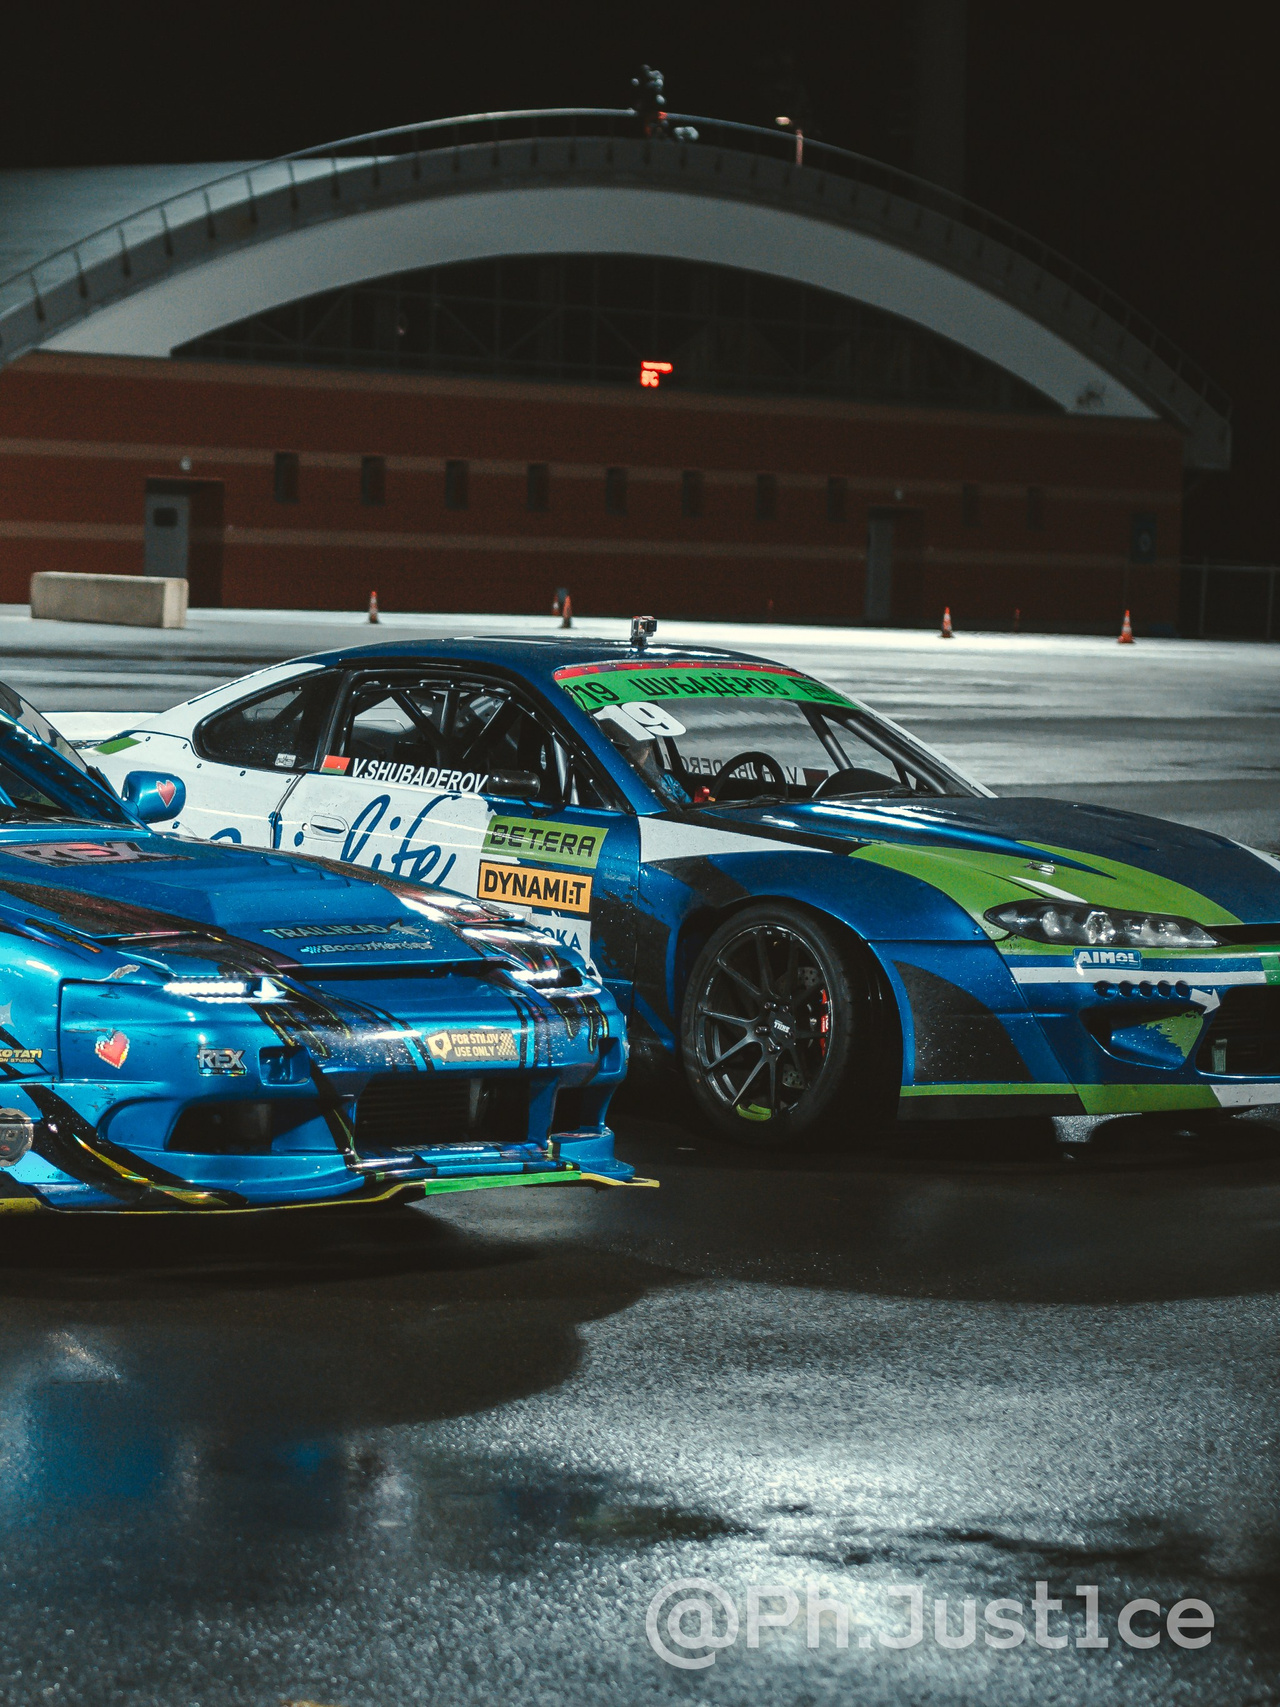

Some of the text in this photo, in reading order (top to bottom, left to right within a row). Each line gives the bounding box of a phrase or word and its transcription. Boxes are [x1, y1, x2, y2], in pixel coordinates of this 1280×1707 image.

[628, 672, 790, 699] ШУБАДЁРОВ
[593, 701, 687, 741] 19
[351, 757, 489, 793] V.SHUBADEROV
[262, 924, 389, 939] TRAILHEAD
[1077, 951, 1138, 964] AIMOL
[451, 1033, 499, 1045] FOR STILOV
[200, 1049, 245, 1068] REX
[454, 1046, 495, 1057] USE ONLY
